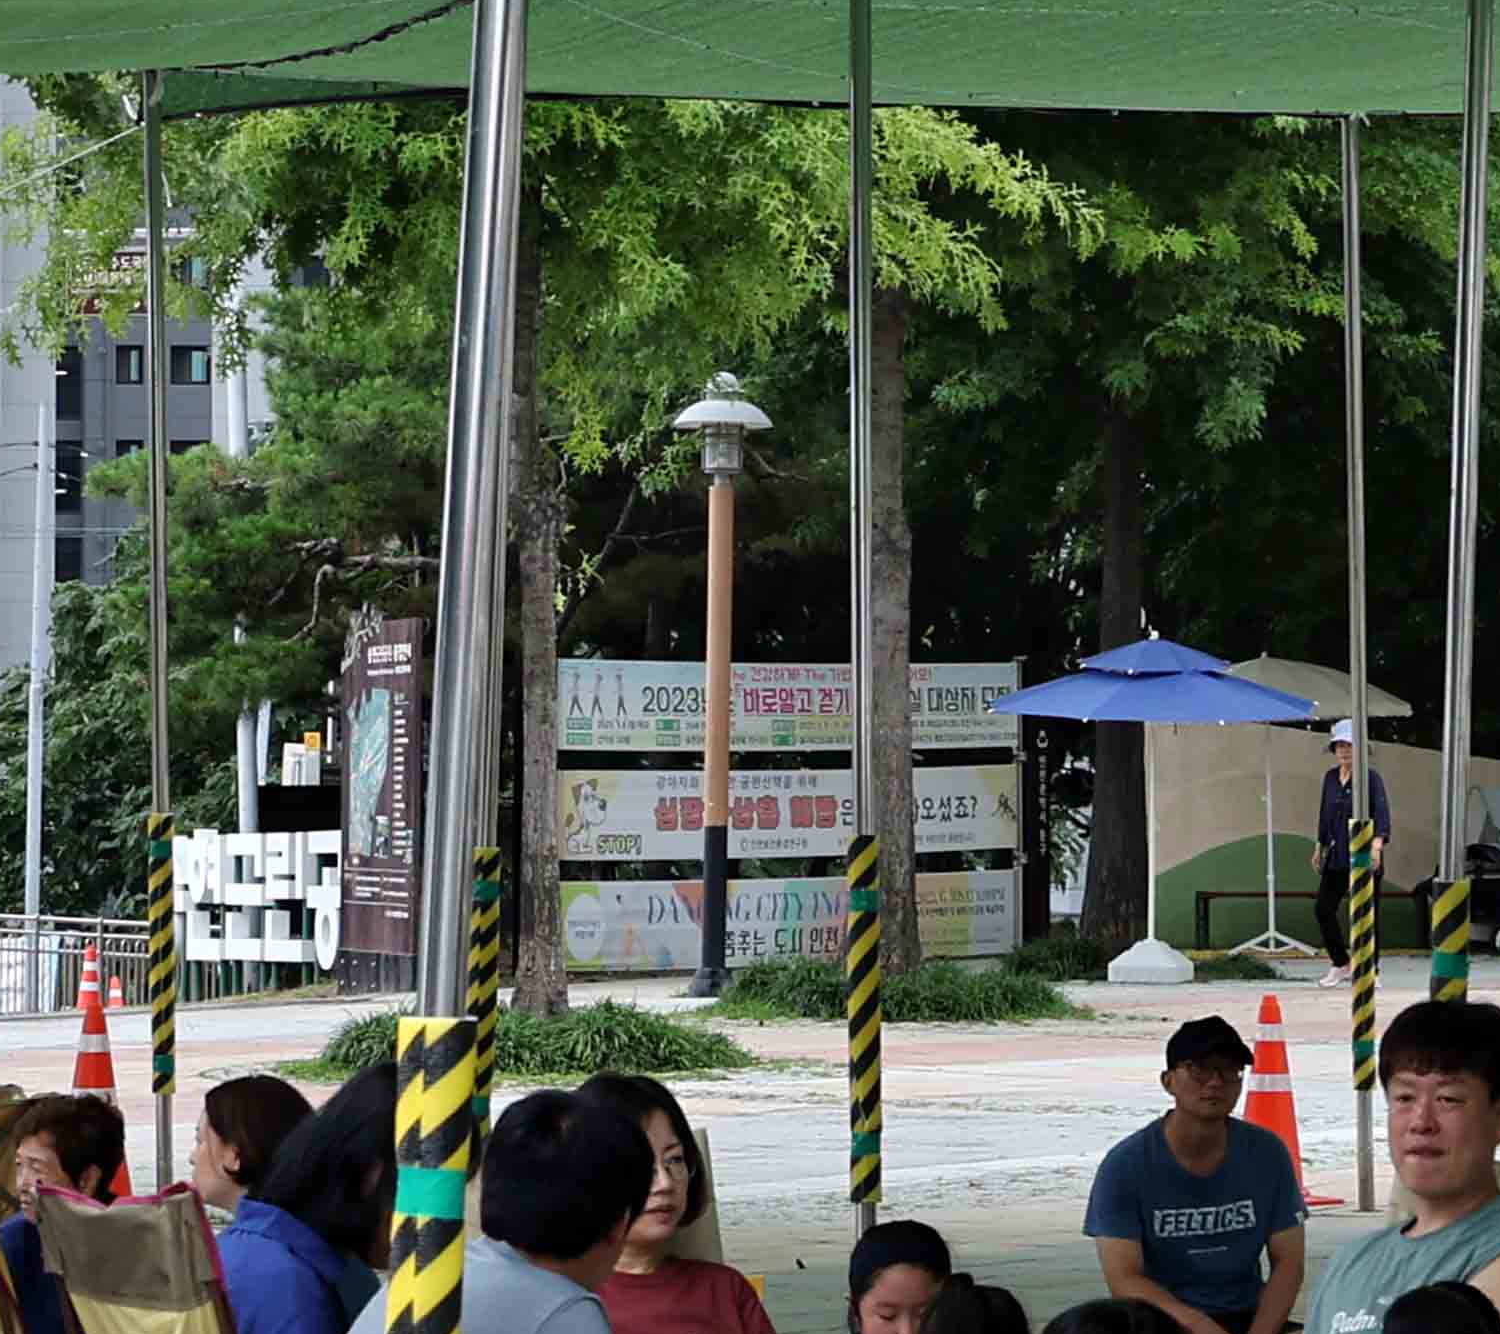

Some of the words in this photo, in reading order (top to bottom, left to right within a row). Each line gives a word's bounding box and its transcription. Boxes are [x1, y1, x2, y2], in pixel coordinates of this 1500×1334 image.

[927, 686, 978, 714] 대상자
[596, 833, 642, 855] STOP!
[774, 928, 802, 955] 도시
